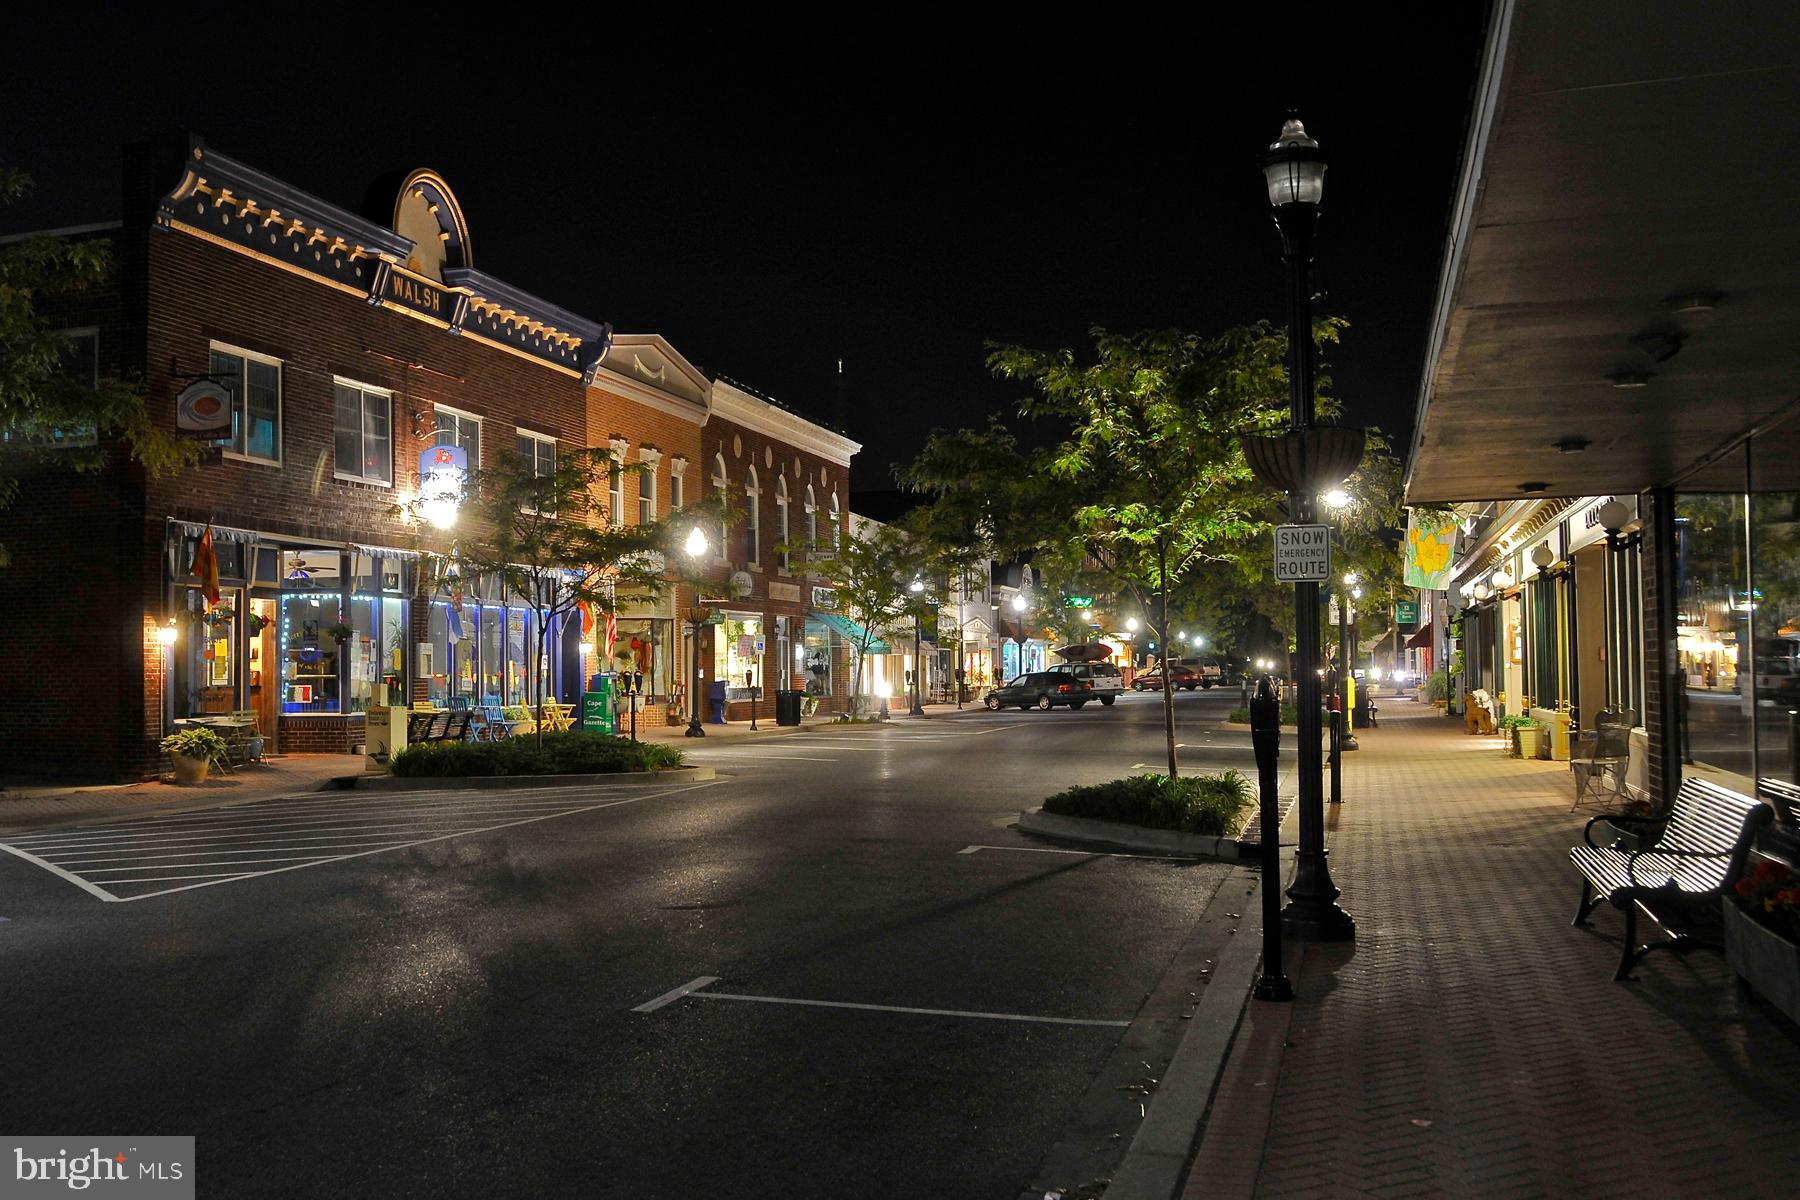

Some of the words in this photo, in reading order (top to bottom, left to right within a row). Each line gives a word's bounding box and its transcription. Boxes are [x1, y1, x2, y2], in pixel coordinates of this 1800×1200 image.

[393, 275, 439, 311] WALSH
[1280, 531, 1324, 545] SNOW
[1279, 548, 1325, 558] EMERGENCY
[1279, 561, 1326, 575] ROUTE
[587, 700, 603, 708] Cape
